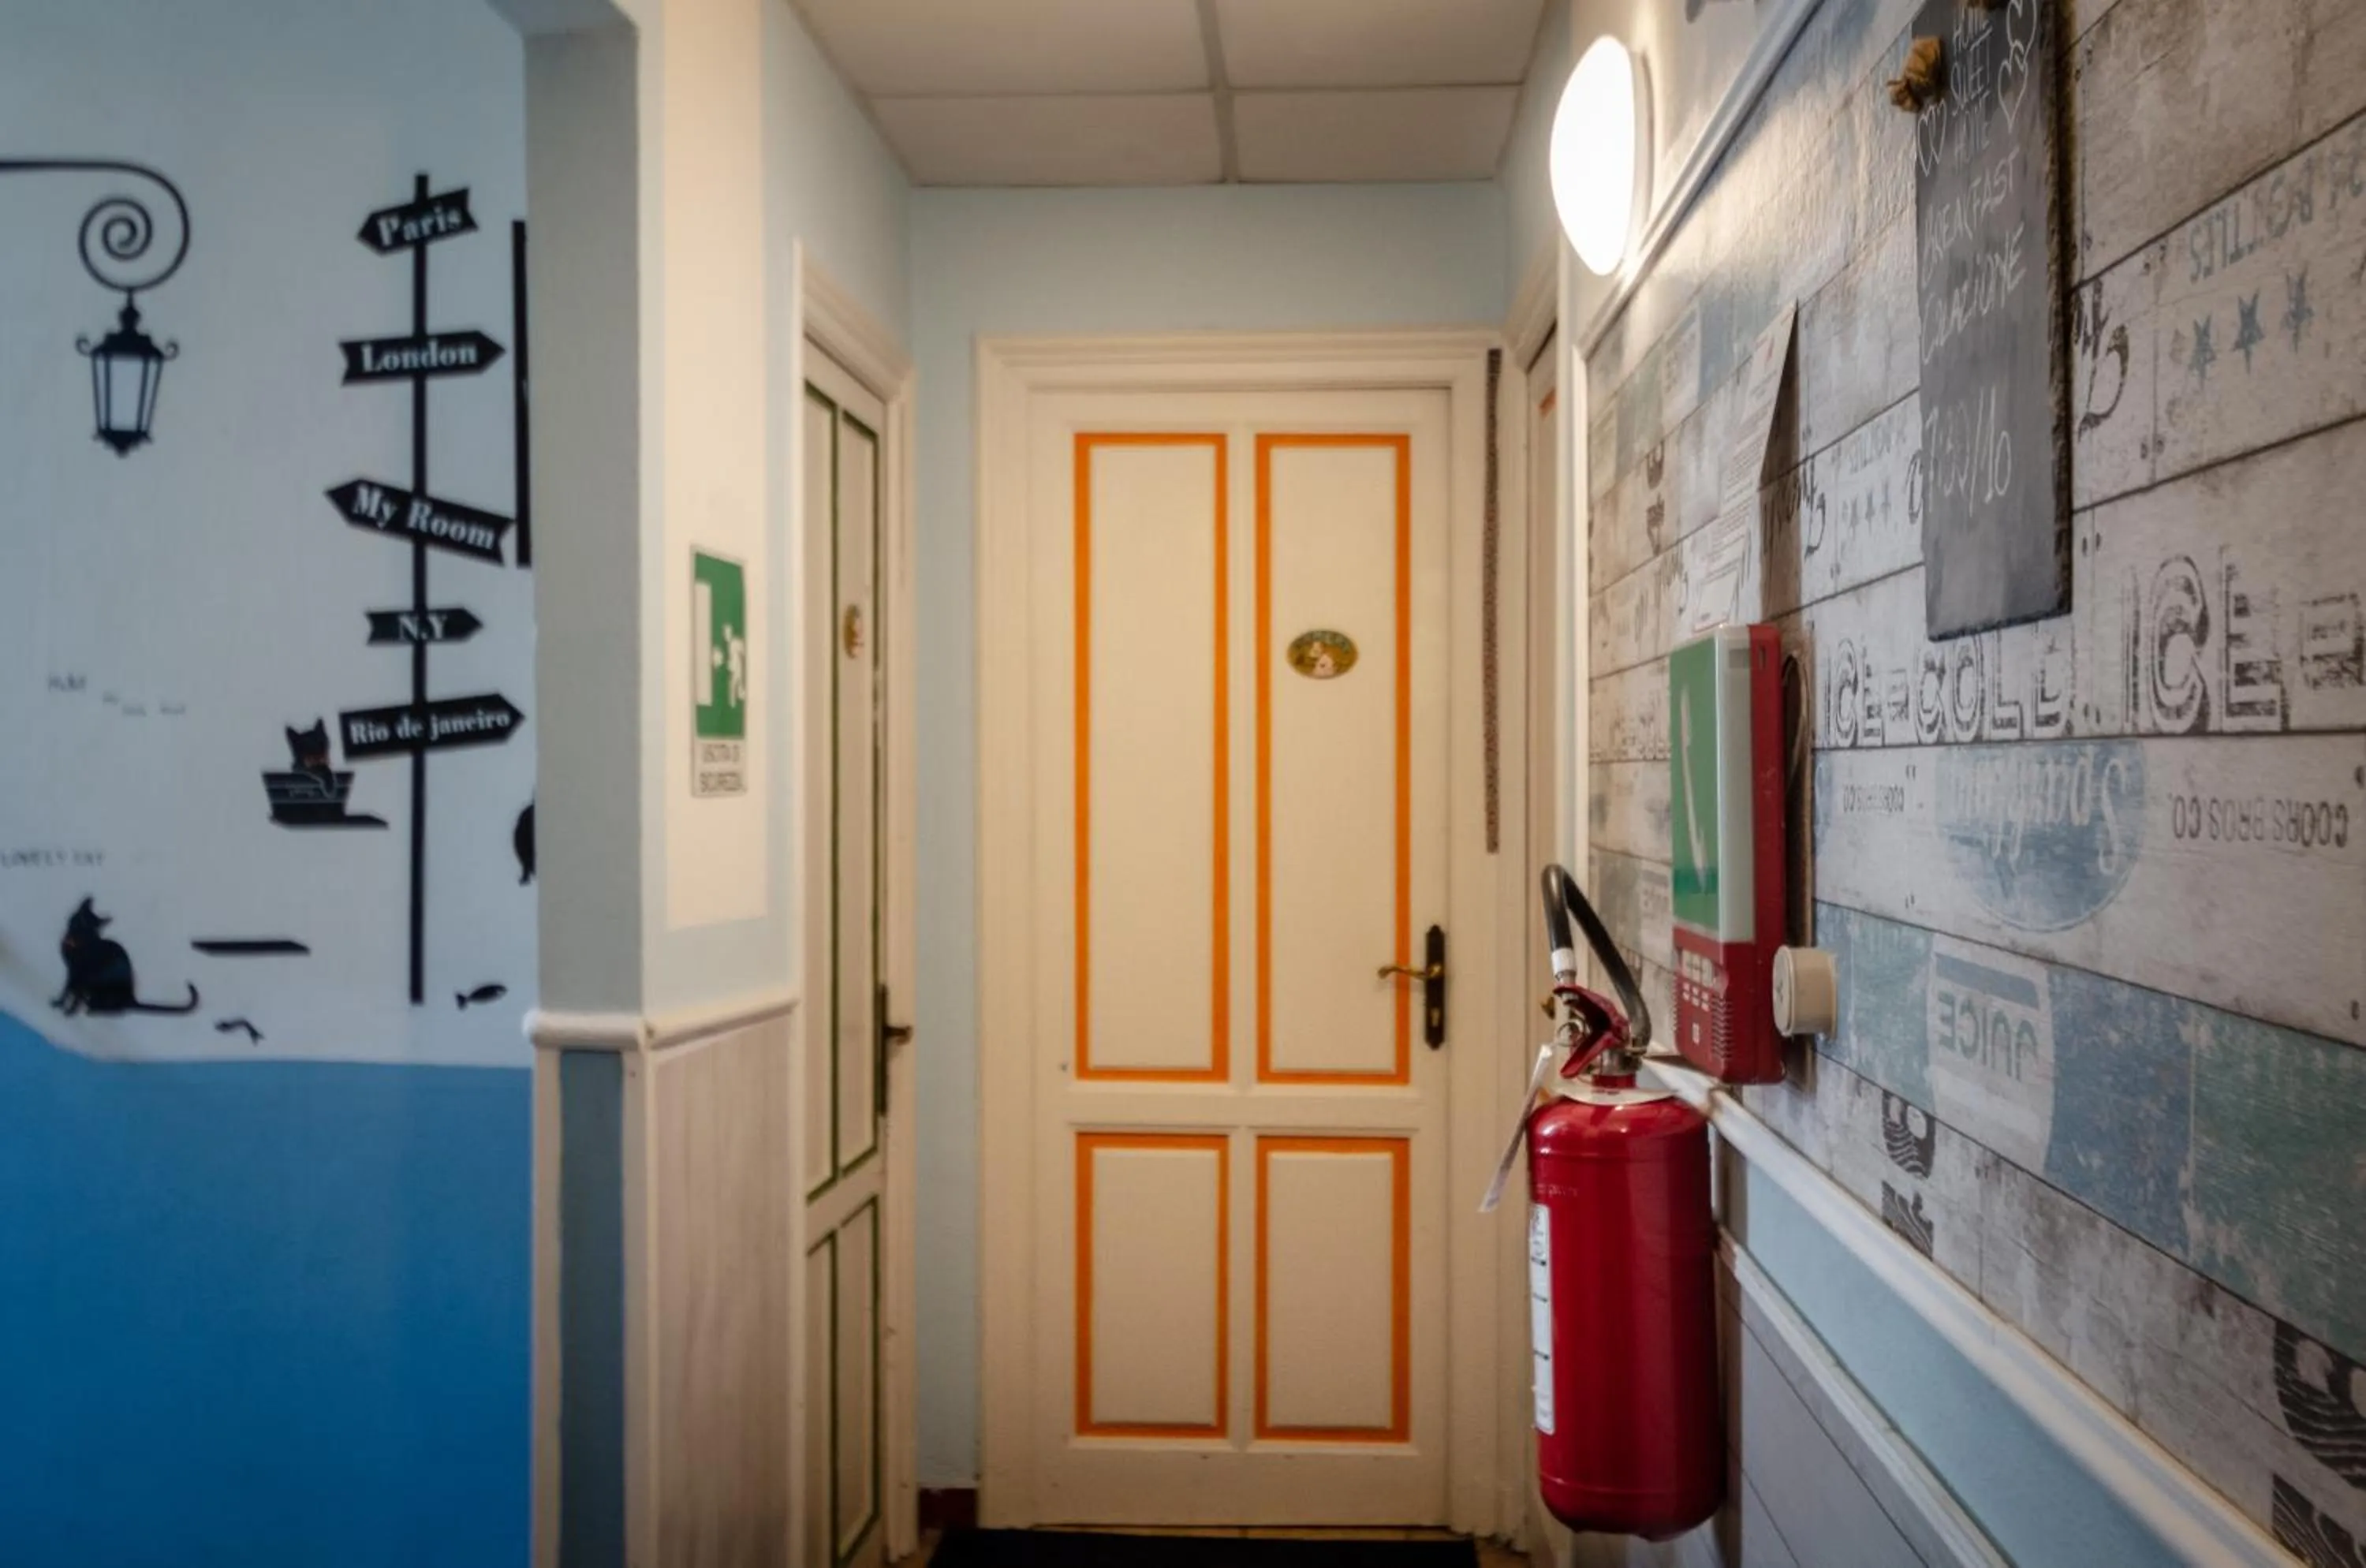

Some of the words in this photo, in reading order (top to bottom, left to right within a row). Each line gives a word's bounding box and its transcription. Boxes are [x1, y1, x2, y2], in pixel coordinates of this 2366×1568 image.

[377, 204, 463, 247] Paris
[360, 338, 478, 372] London
[352, 483, 398, 529] My
[407, 498, 498, 551] Room
[349, 717, 390, 745] Rio
[396, 712, 423, 739] de
[430, 707, 512, 741] janeiro
[1938, 991, 2039, 1083] JUICE
